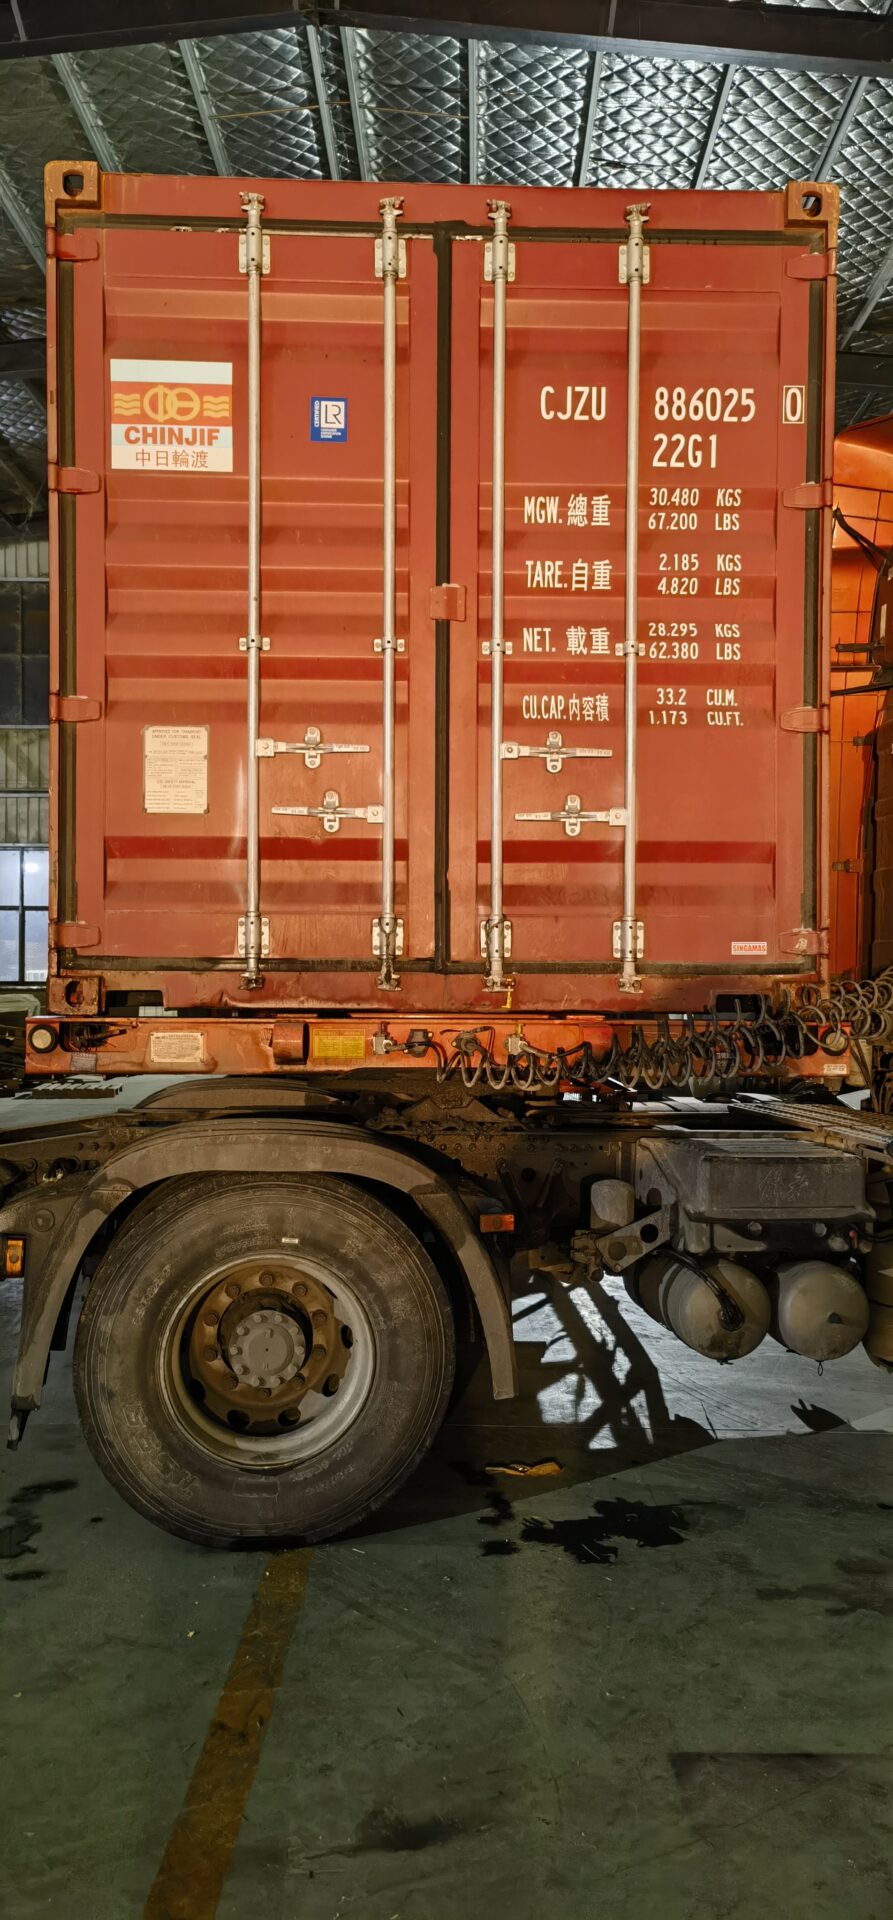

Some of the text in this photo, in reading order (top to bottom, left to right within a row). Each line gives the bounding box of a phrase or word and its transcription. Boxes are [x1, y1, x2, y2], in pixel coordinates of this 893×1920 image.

[540, 386, 802, 422] CJZU 886025 0
[124, 426, 220, 446] CHINJIF
[136, 449, 209, 469] 中日輪渡
[652, 433, 717, 468] 22G1
[716, 488, 742, 507] KGS
[715, 512, 740, 531] LBS
[716, 554, 742, 572] KGS
[715, 577, 741, 595] LBS
[715, 623, 740, 638] KGS
[523, 625, 611, 656] NET. 載重
[716, 642, 741, 661] LBS
[656, 687, 738, 707] 33.2 CU.M.
[707, 711, 744, 726] CU.FT.
[732, 944, 766, 952] SINGAMAS
